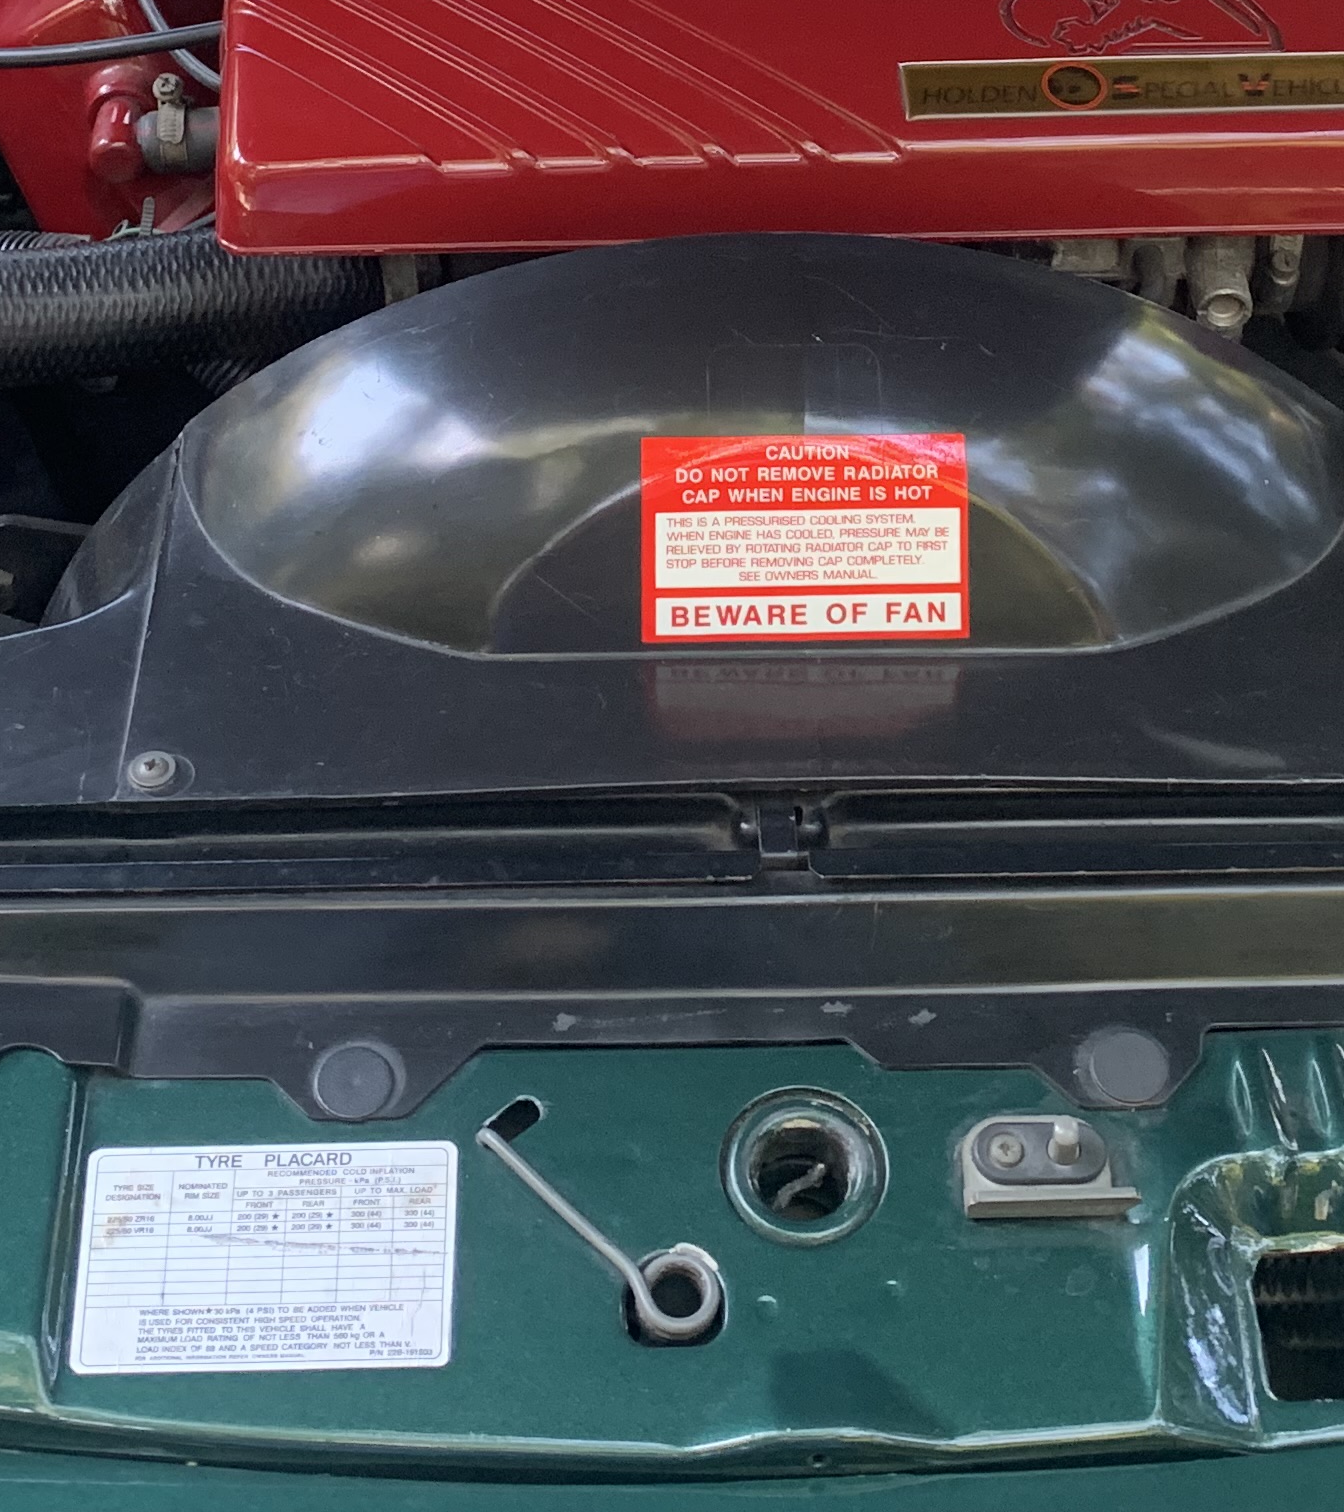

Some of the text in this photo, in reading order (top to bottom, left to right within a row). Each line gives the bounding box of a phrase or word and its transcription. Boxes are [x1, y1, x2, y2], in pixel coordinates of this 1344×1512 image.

[921, 85, 1037, 106] HOLDEN
[766, 444, 851, 460] CAUTION
[675, 462, 937, 483] DO NOT REMOVE RADIATOR
[682, 485, 932, 504] CAP WHEN ENGINE IS HOT
[666, 517, 692, 527] THIS
[697, 516, 707, 527] IS
[711, 516, 720, 526] A
[724, 515, 805, 526] PRESSURISED
[809, 514, 861, 525] COOLING
[666, 530, 704, 541] WHEN
[709, 529, 751, 540] ENGINE
[756, 529, 781, 540] HAS
[839, 527, 900, 538] PRESSURE
[905, 527, 930, 537] MAY
[934, 526, 948, 537] BE
[666, 540, 947, 555] RELIEVED BY ROTATING RADIATOR CAP TO FIRST
[666, 558, 696, 569] STOP
[701, 557, 745, 568] BEFORE
[750, 556, 813, 567] REMOVING
[818, 555, 842, 566] CAP
[739, 571, 760, 581] SEE
[765, 570, 818, 581] OWNERS
[671, 601, 945, 627] BEWARE OF FAN
[195, 1152, 352, 1168] TYRE PLACARD
[268, 1169, 337, 1177] RECOMMENDED
[178, 1182, 228, 1190] NOMINATED
[299, 1177, 345, 1185] PRESSURE
[202, 1191, 219, 1199] SIZE
[275, 1188, 337, 1196] PASSENGERS
[370, 1186, 382, 1194] TO
[410, 1186, 433, 1194] LOAD
[105, 1193, 160, 1201] DESIGNATION
[353, 1198, 380, 1206] FRONT
[139, 1308, 169, 1316] WHERE
[172, 1308, 206, 1316] SHOWN
[307, 1305, 336, 1313] ADDED
[340, 1304, 366, 1312] WHEN
[369, 1303, 403, 1311] VEHICLE
[138, 1318, 146, 1326] IS
[148, 1318, 171, 1326] USED
[196, 1316, 250, 1325] CONSISTENT
[254, 1316, 276, 1324] HIGH
[278, 1315, 306, 1323] SPEED
